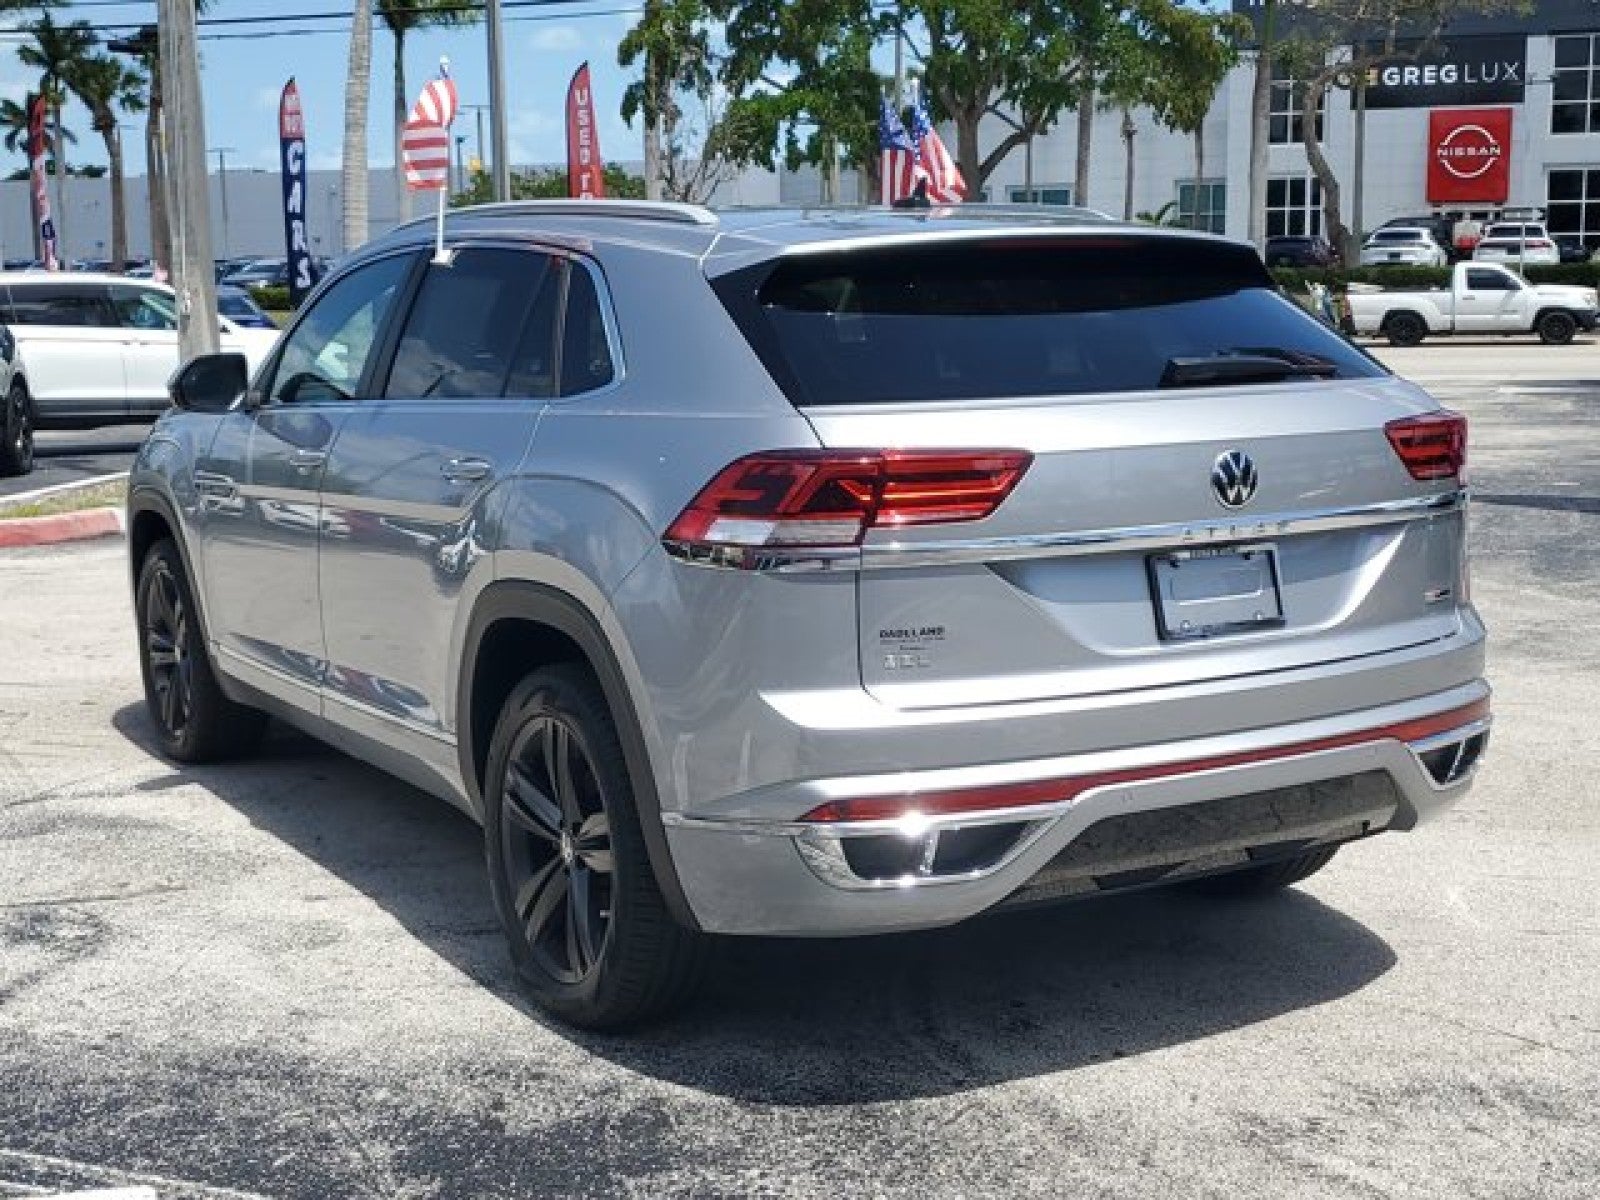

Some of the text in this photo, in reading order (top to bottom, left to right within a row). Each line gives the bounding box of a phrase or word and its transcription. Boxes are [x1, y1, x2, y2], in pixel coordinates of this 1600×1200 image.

[1382, 64, 1458, 86] GREG
[1464, 62, 1521, 83] LUX
[1437, 146, 1501, 157] NISSAN
[287, 139, 311, 288] CARS
